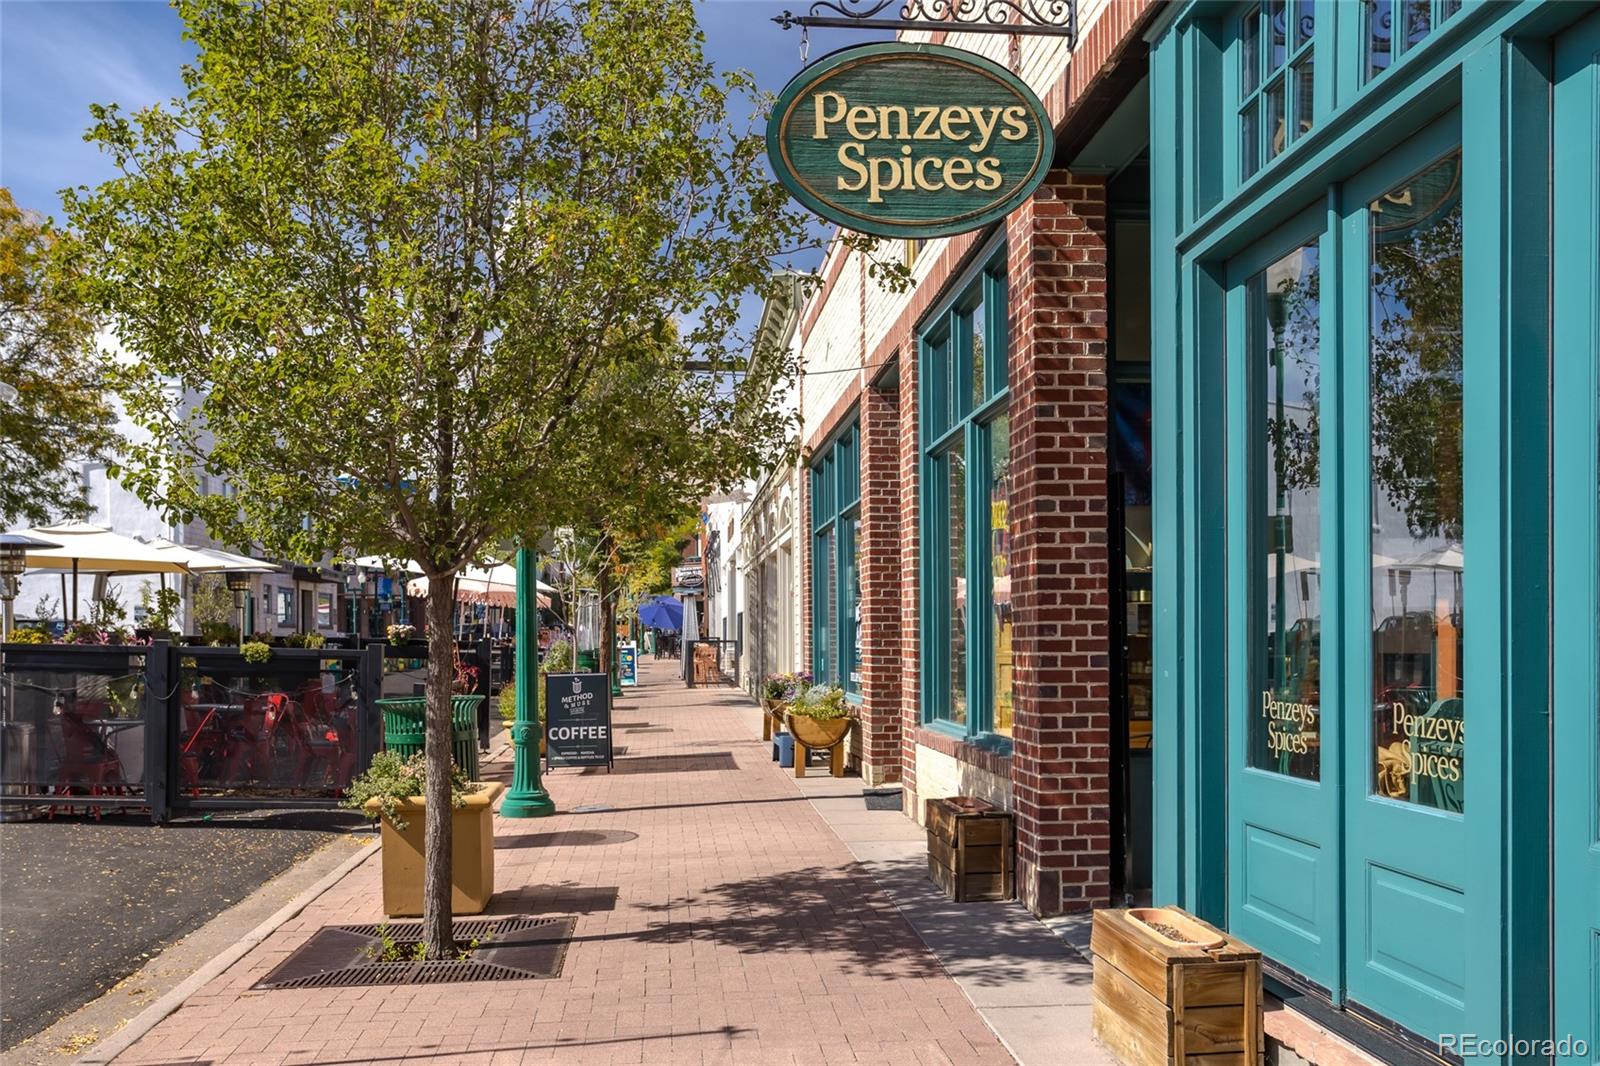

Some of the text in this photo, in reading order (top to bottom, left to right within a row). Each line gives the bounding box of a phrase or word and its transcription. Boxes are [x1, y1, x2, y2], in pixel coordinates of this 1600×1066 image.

[813, 91, 1029, 153] Penzeys
[837, 142, 1002, 203] Spices
[561, 692, 593, 704] METHOD
[1262, 690, 1315, 730] Penzeys
[548, 725, 607, 741] COFFEE
[1267, 721, 1308, 758] Spices
[1401, 739, 1460, 785] Spices
